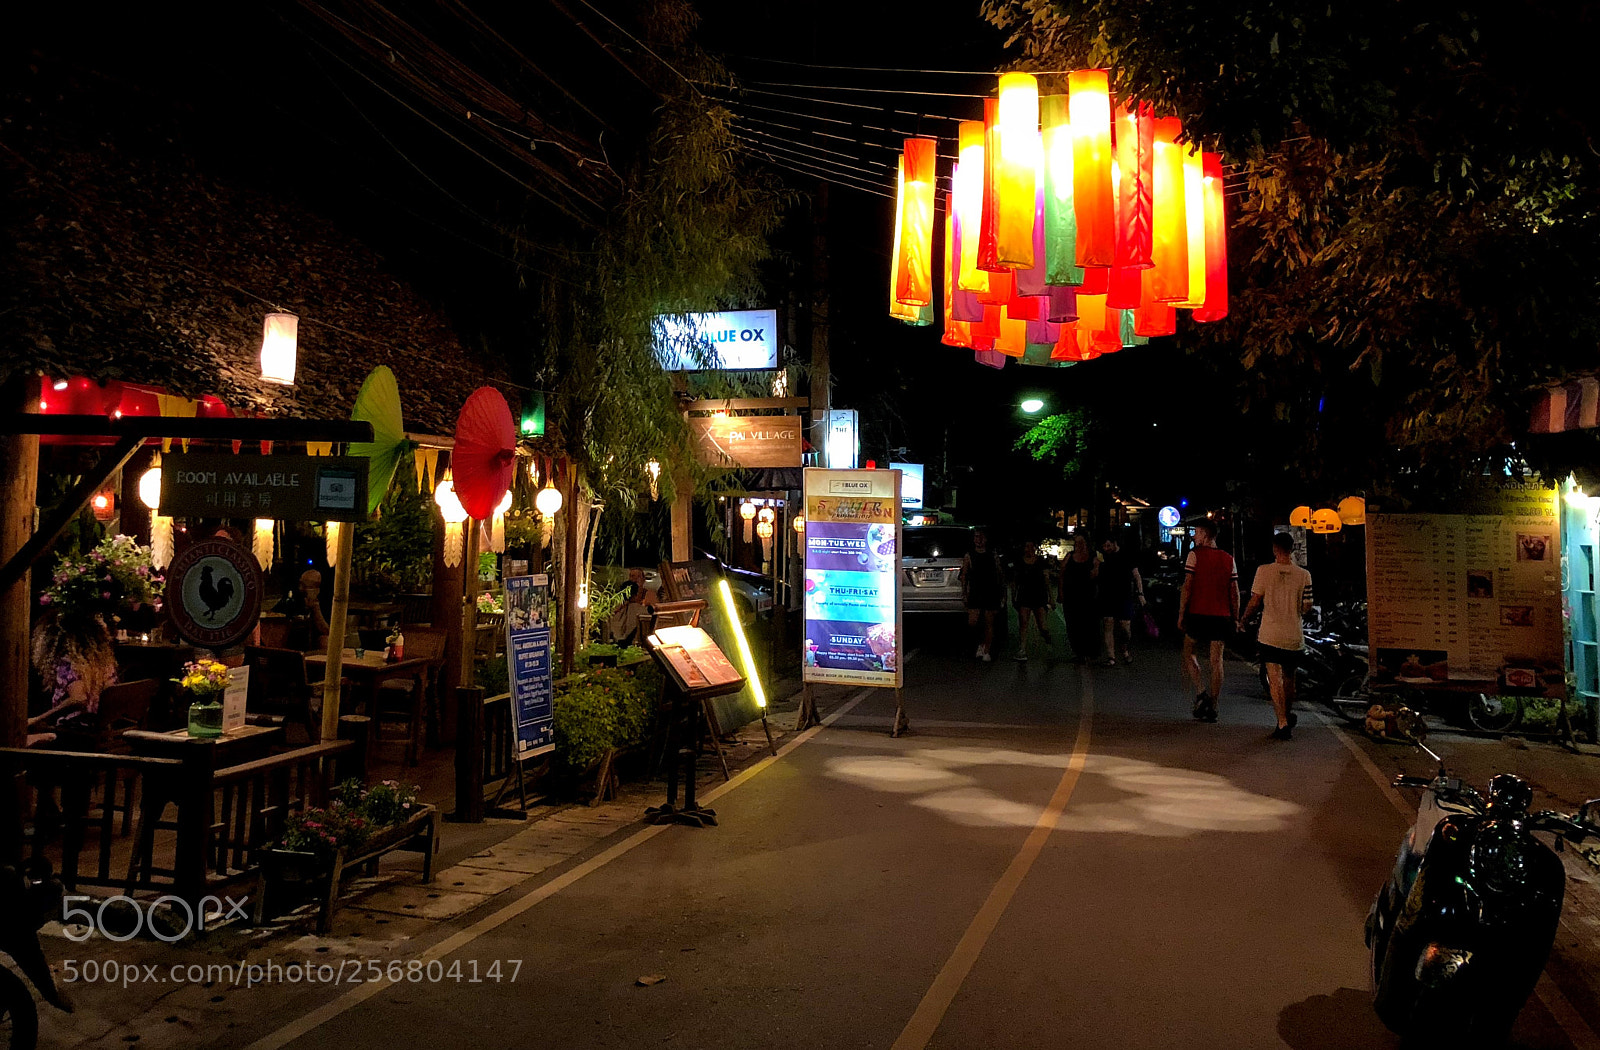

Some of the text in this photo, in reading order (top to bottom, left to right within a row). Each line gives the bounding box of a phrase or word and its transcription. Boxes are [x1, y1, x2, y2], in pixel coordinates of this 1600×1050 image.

[740, 328, 764, 342] OX
[729, 430, 795, 444] PAI VILLAGE
[176, 470, 300, 487] ROOM AVAILABLE
